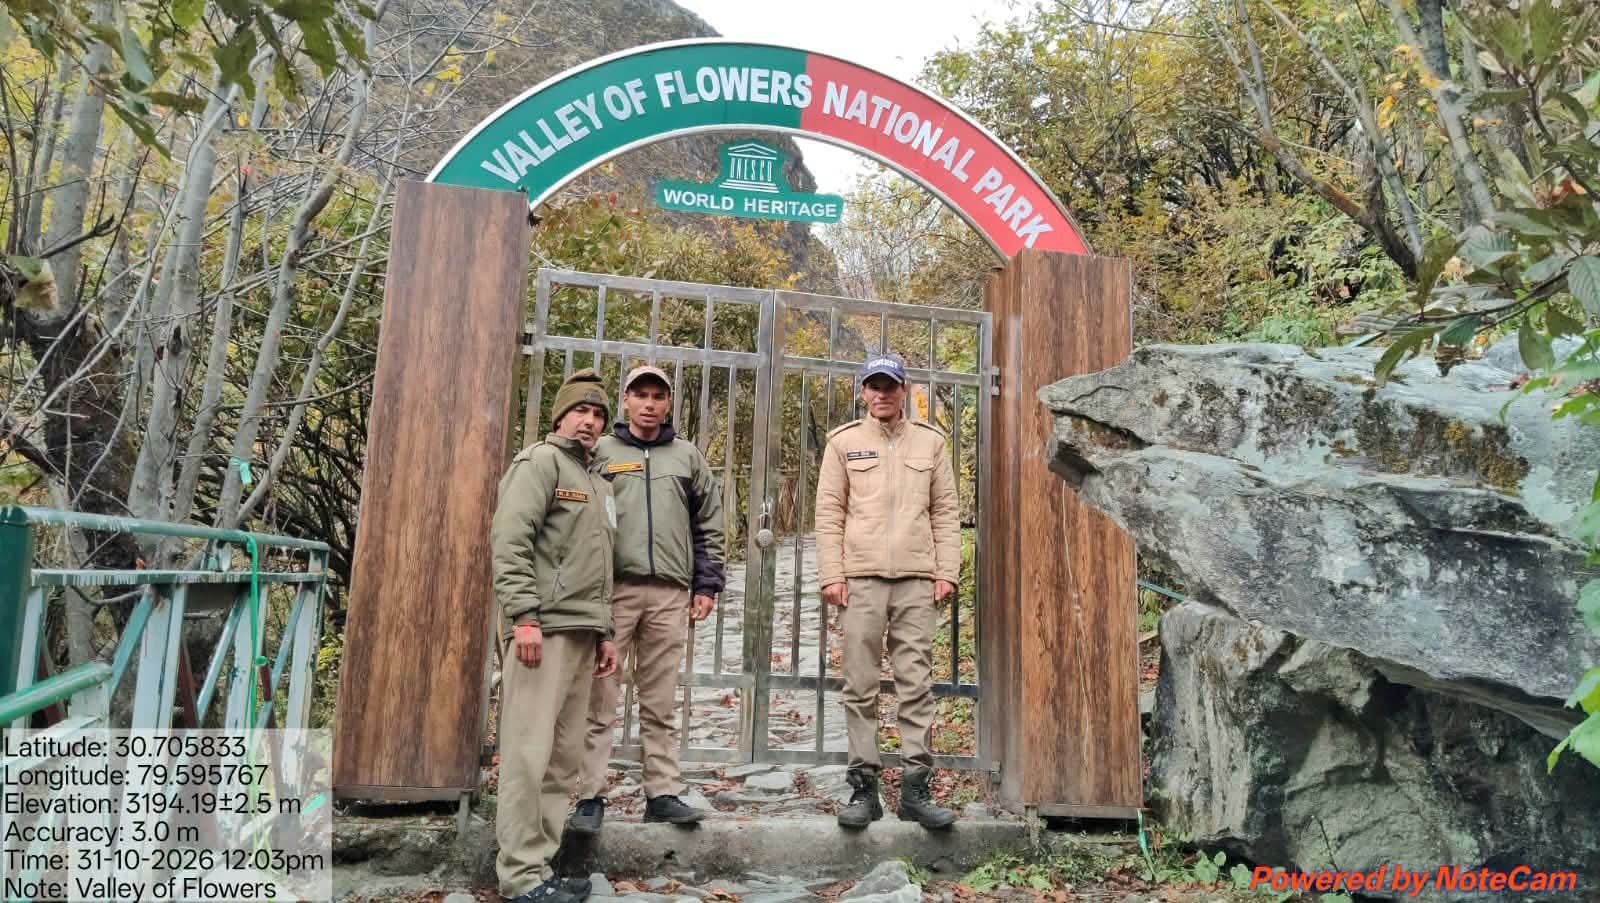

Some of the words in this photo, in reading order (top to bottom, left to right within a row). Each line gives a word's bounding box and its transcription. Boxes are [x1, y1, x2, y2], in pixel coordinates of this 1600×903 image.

[480, 92, 603, 184] VALLEY
[603, 78, 648, 121] OF
[655, 66, 811, 109] FLOWERS
[823, 81, 976, 183] NATIONAL
[972, 167, 1053, 248] PARK
[730, 157, 773, 182] UNESCO
[663, 188, 734, 211] WORLD
[744, 197, 837, 218] HERITAGE
